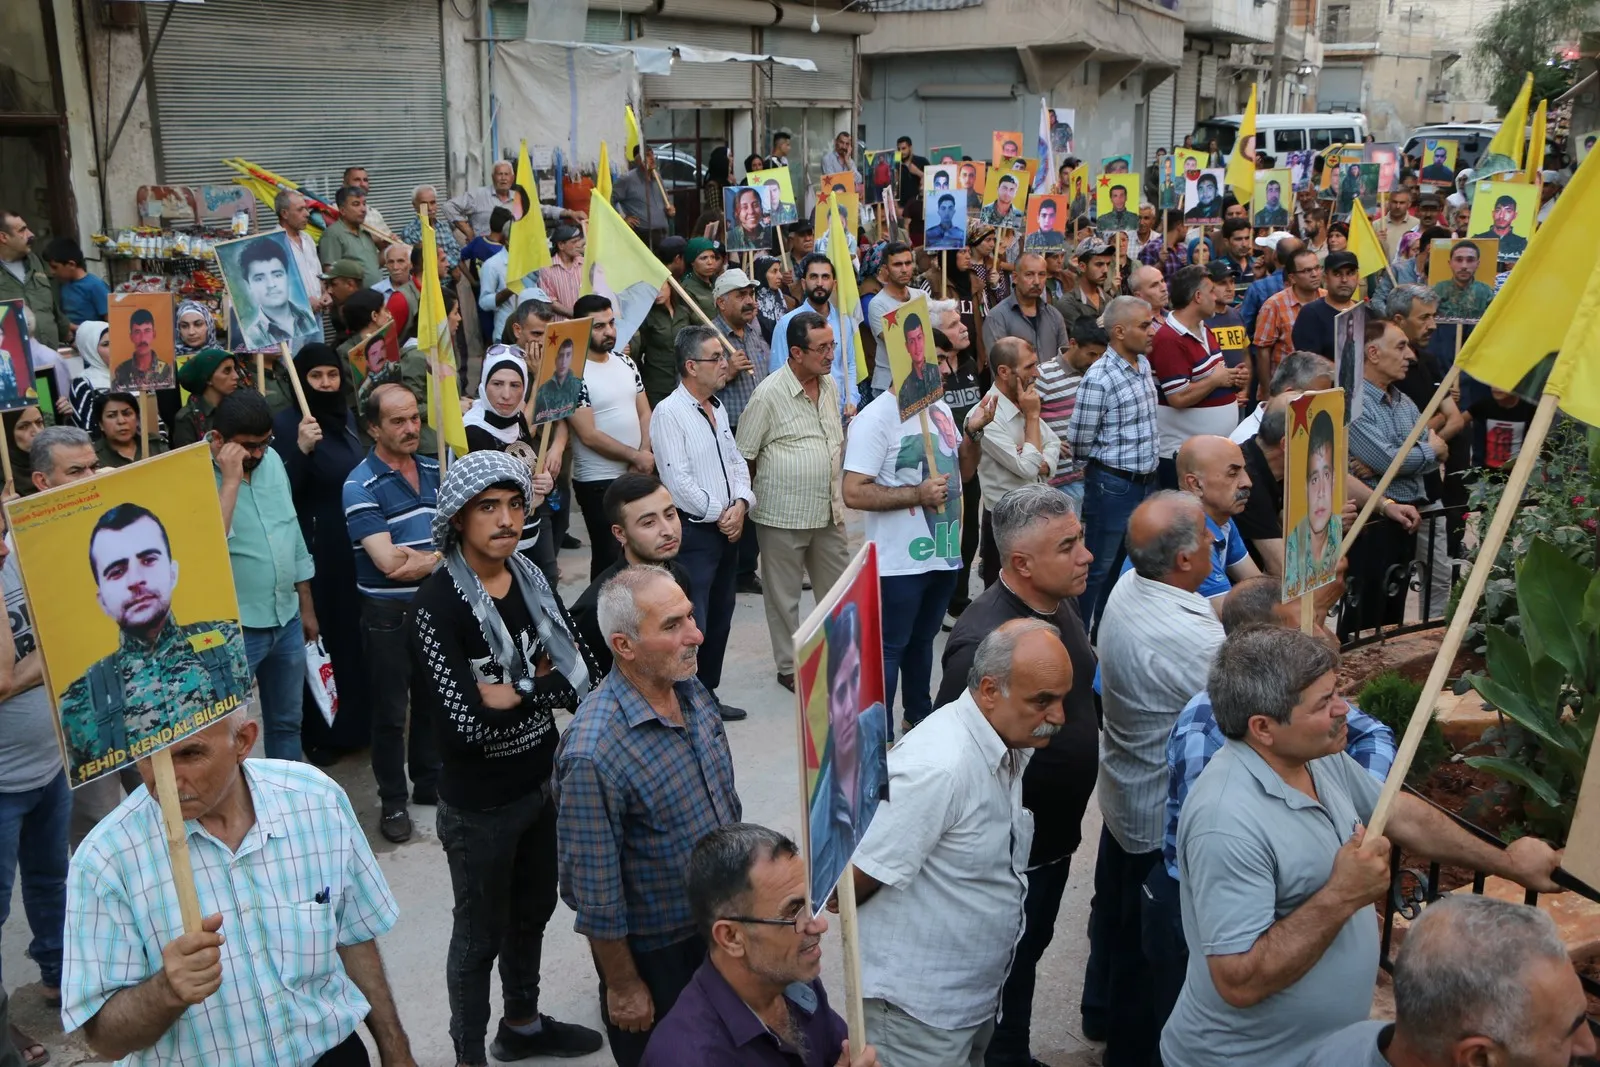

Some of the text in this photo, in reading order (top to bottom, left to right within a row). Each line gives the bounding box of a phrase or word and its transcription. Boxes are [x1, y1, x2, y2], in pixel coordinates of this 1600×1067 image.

[908, 519, 961, 561] elf
[78, 747, 127, 782] ŞEHÎD
[130, 719, 193, 757] KENDAL
